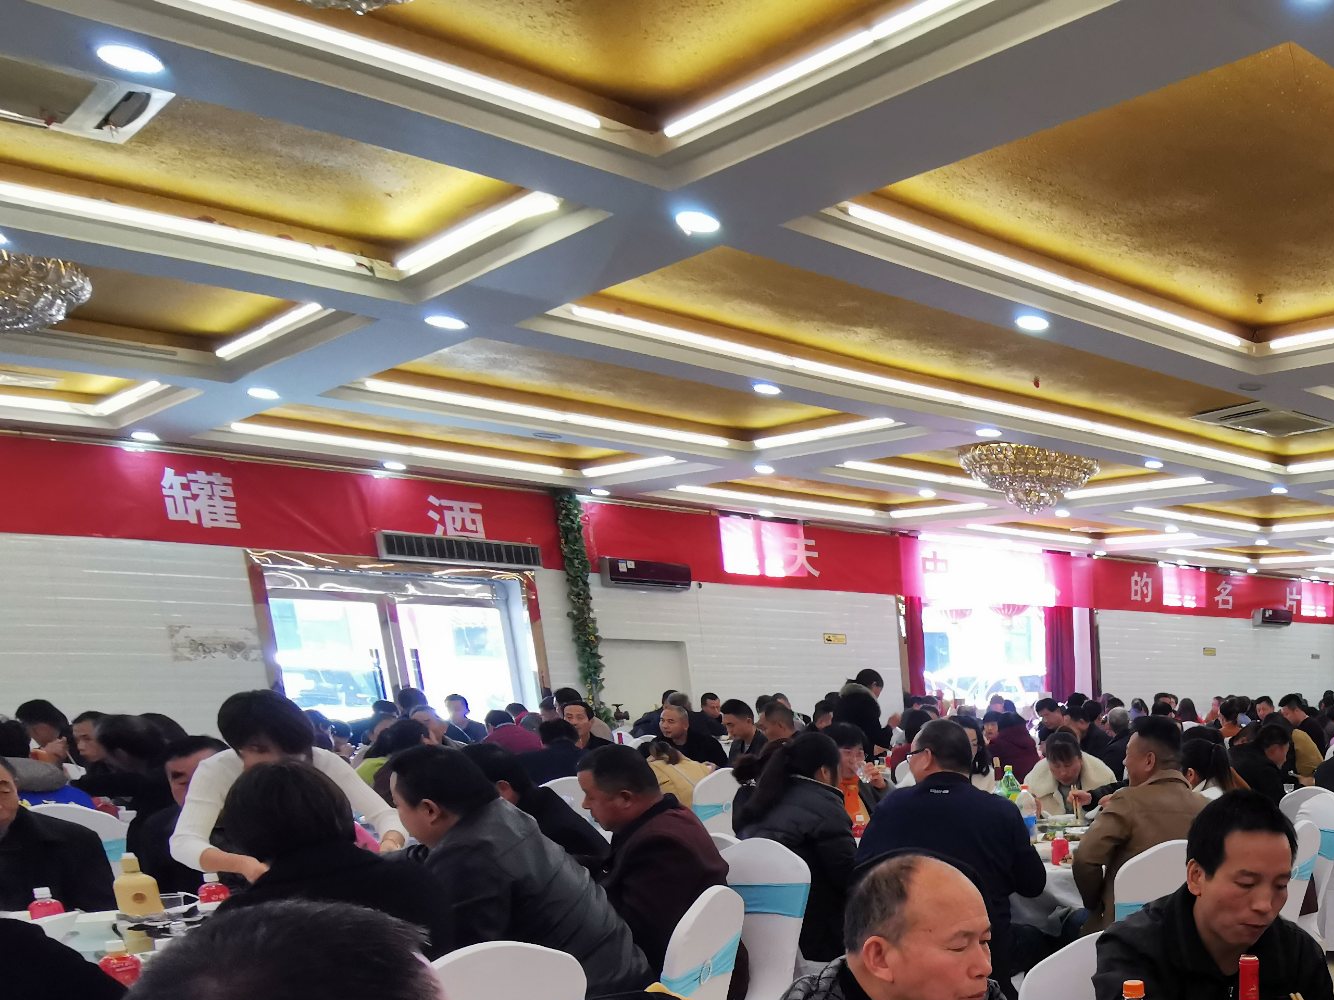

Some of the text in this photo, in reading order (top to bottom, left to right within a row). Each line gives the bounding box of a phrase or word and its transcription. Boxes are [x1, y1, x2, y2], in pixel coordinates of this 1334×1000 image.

[161, 467, 241, 530] 罐
[782, 536, 820, 577] 天
[1130, 571, 1153, 603] 的
[1214, 580, 1233, 610] 名
